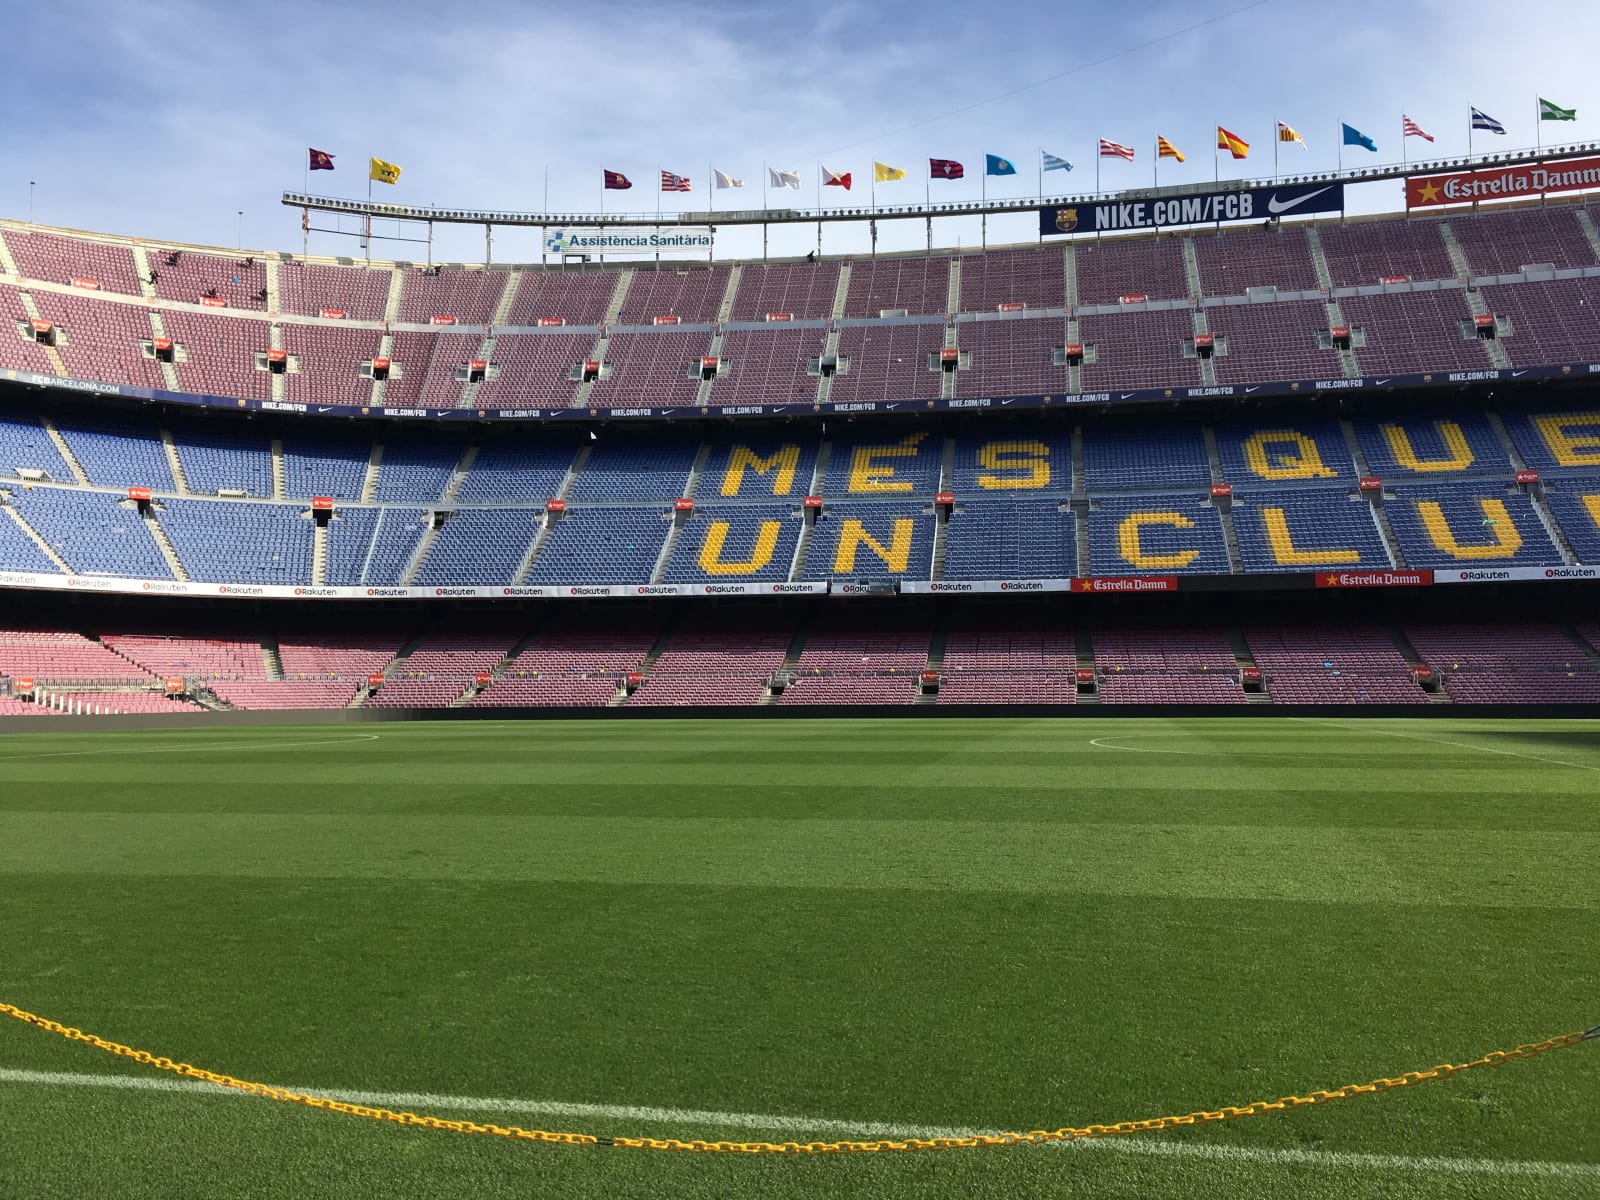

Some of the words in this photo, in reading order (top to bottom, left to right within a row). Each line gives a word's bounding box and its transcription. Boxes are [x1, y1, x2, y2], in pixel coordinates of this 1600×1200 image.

[1443, 173, 1528, 199] Estrella
[1530, 168, 1600, 191] Damm
[1095, 193, 1253, 230] NIKE.COM/FCB
[569, 235, 648, 247] Assistència
[649, 234, 709, 246] Sanitària
[32, 374, 120, 394] FCBARCELONA.COM
[719, 432, 1051, 496] MÉS
[1244, 415, 1600, 480] QUE
[699, 518, 914, 575] UN
[1118, 495, 1600, 569] CLU
[1468, 570, 1510, 580] Rakuten
[1553, 568, 1596, 578] Rakuten
[1339, 573, 1383, 586] Estrella
[1383, 573, 1421, 585] Damm
[779, 584, 813, 593] Rakuten
[938, 583, 972, 592] Rakuten
[1008, 582, 1043, 591] Rakuten
[1093, 578, 1133, 591] Estrella
[1133, 579, 1167, 590] Damm
[226, 586, 263, 595] Rakuten
[301, 587, 337, 596] Rakuten
[374, 588, 408, 597] Rakuten
[442, 588, 476, 596] Rakuten
[510, 587, 543, 596] Rakuten
[577, 587, 610, 596] Rakuten
[644, 586, 677, 595] Rakuten
[712, 585, 745, 594] Rakuten
